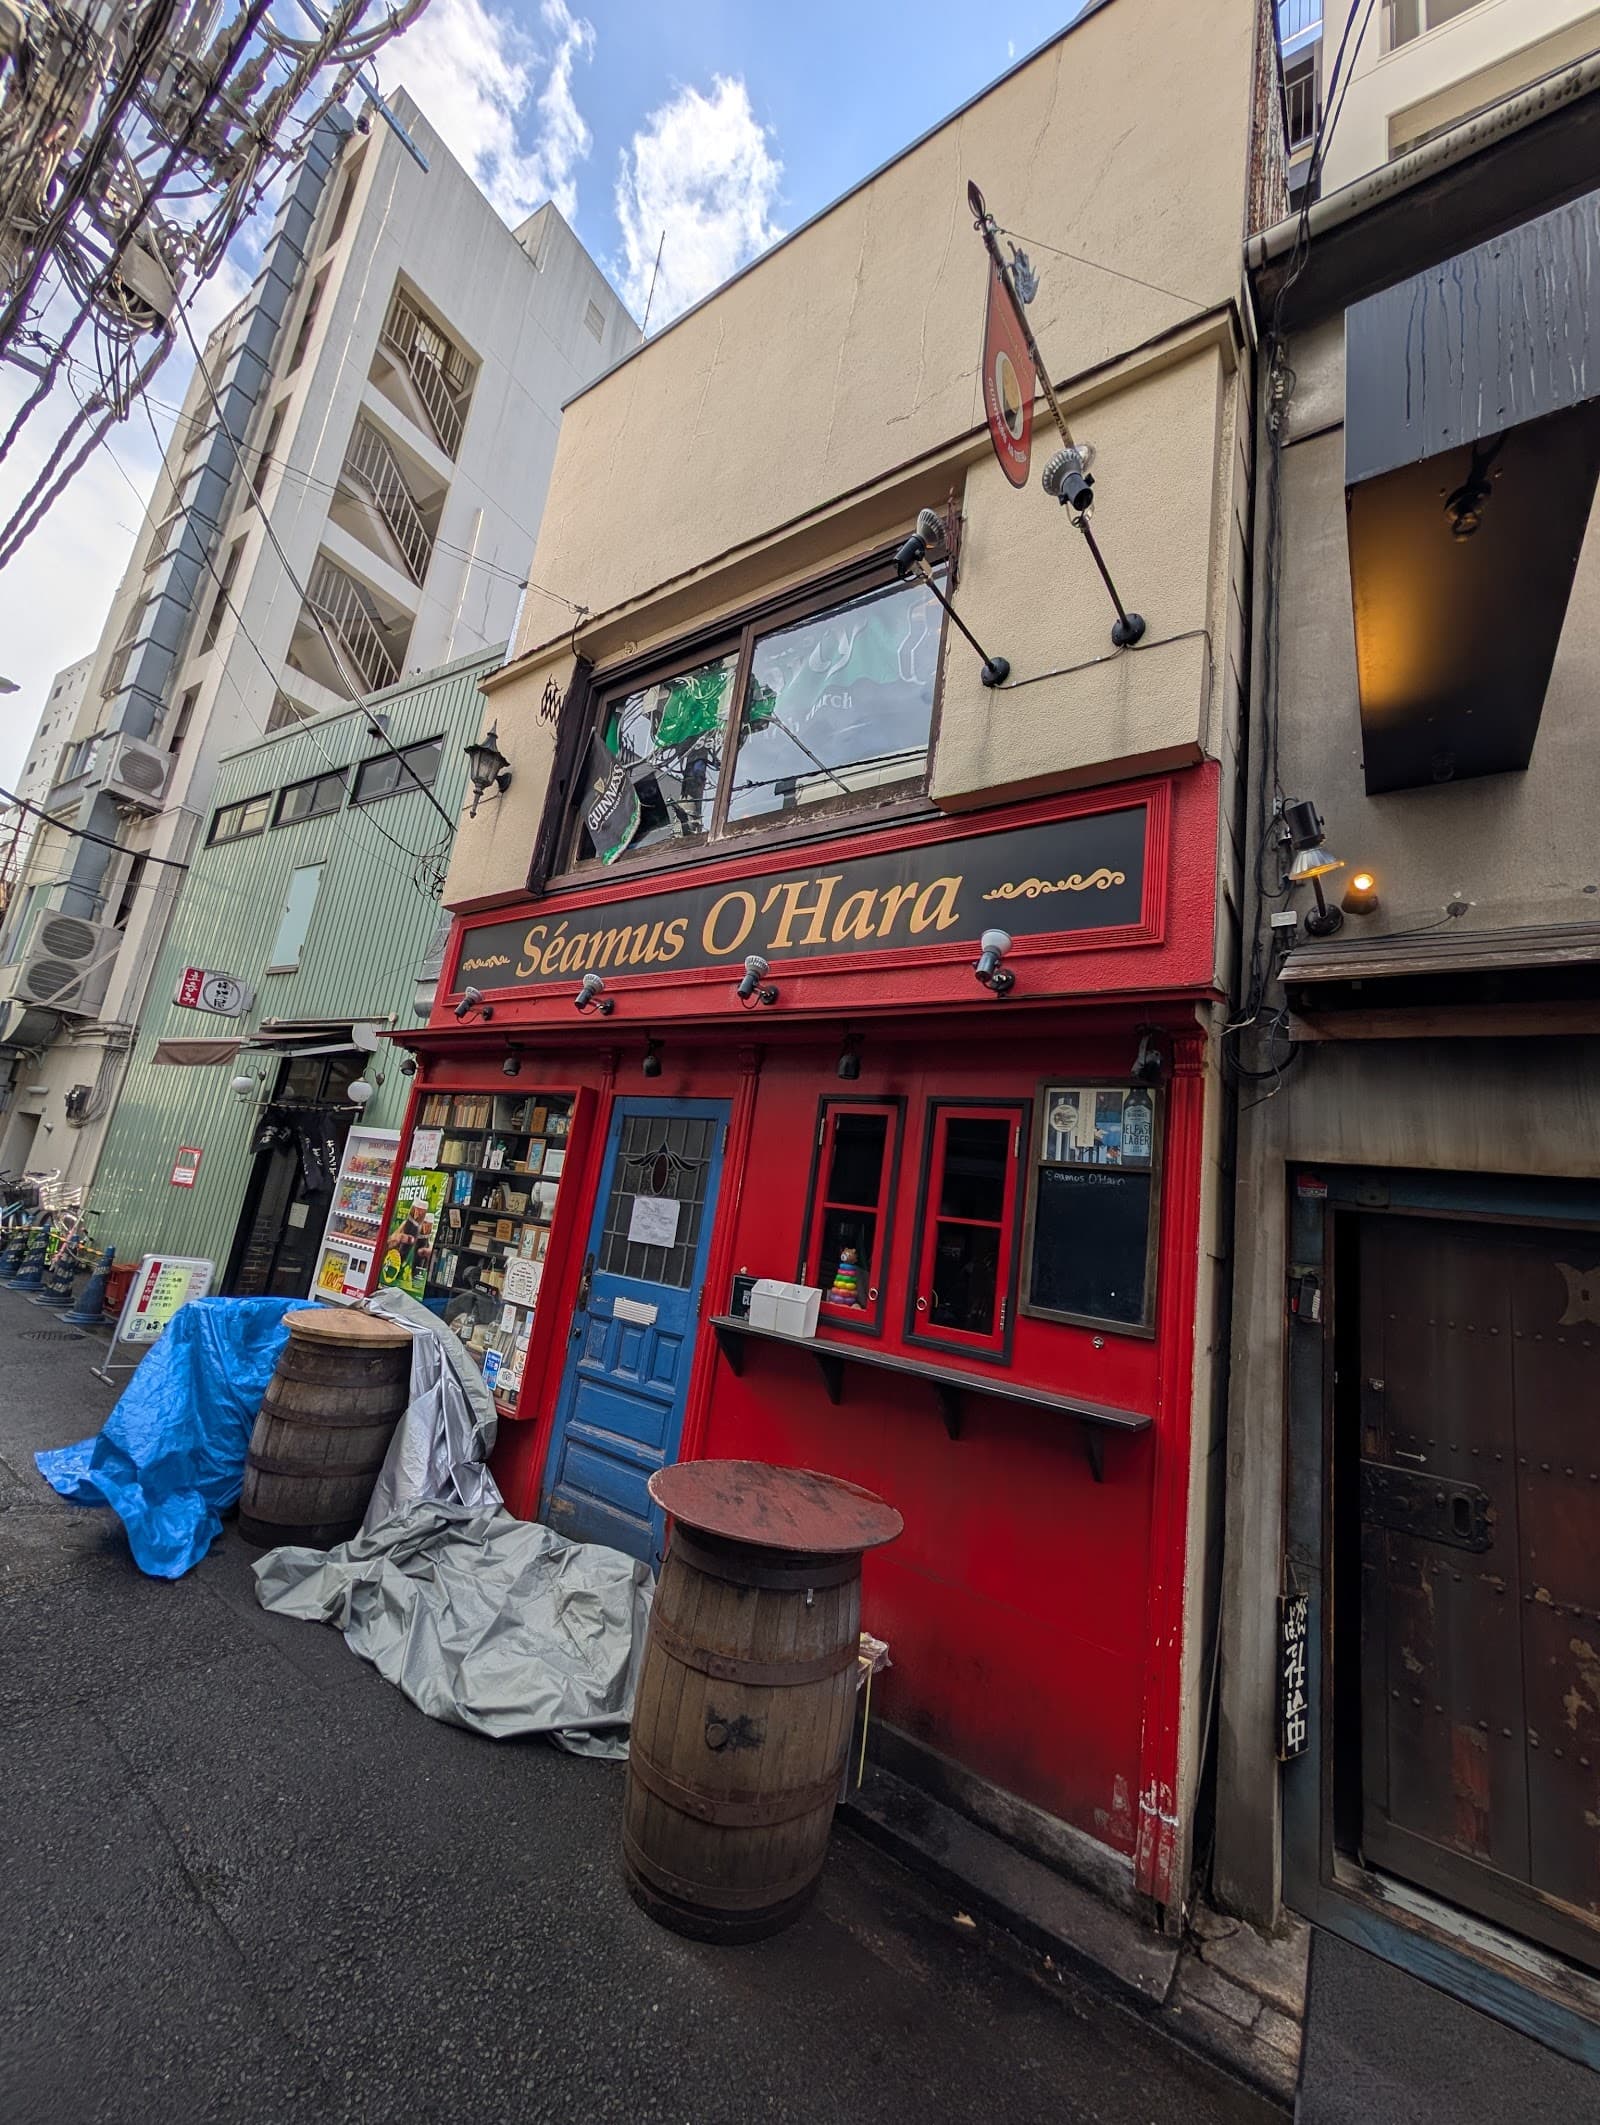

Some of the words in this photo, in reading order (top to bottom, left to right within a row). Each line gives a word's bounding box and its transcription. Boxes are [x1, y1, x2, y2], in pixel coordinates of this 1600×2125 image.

[588, 764, 625, 831] GUINNESS
[515, 917, 689, 978] Séamus
[702, 874, 964, 956] O'Hara
[1124, 1136, 1149, 1146] LAGER
[402, 1176, 420, 1186] MAKE
[420, 1174, 428, 1184] IT
[399, 1186, 429, 1201] GREEN!
